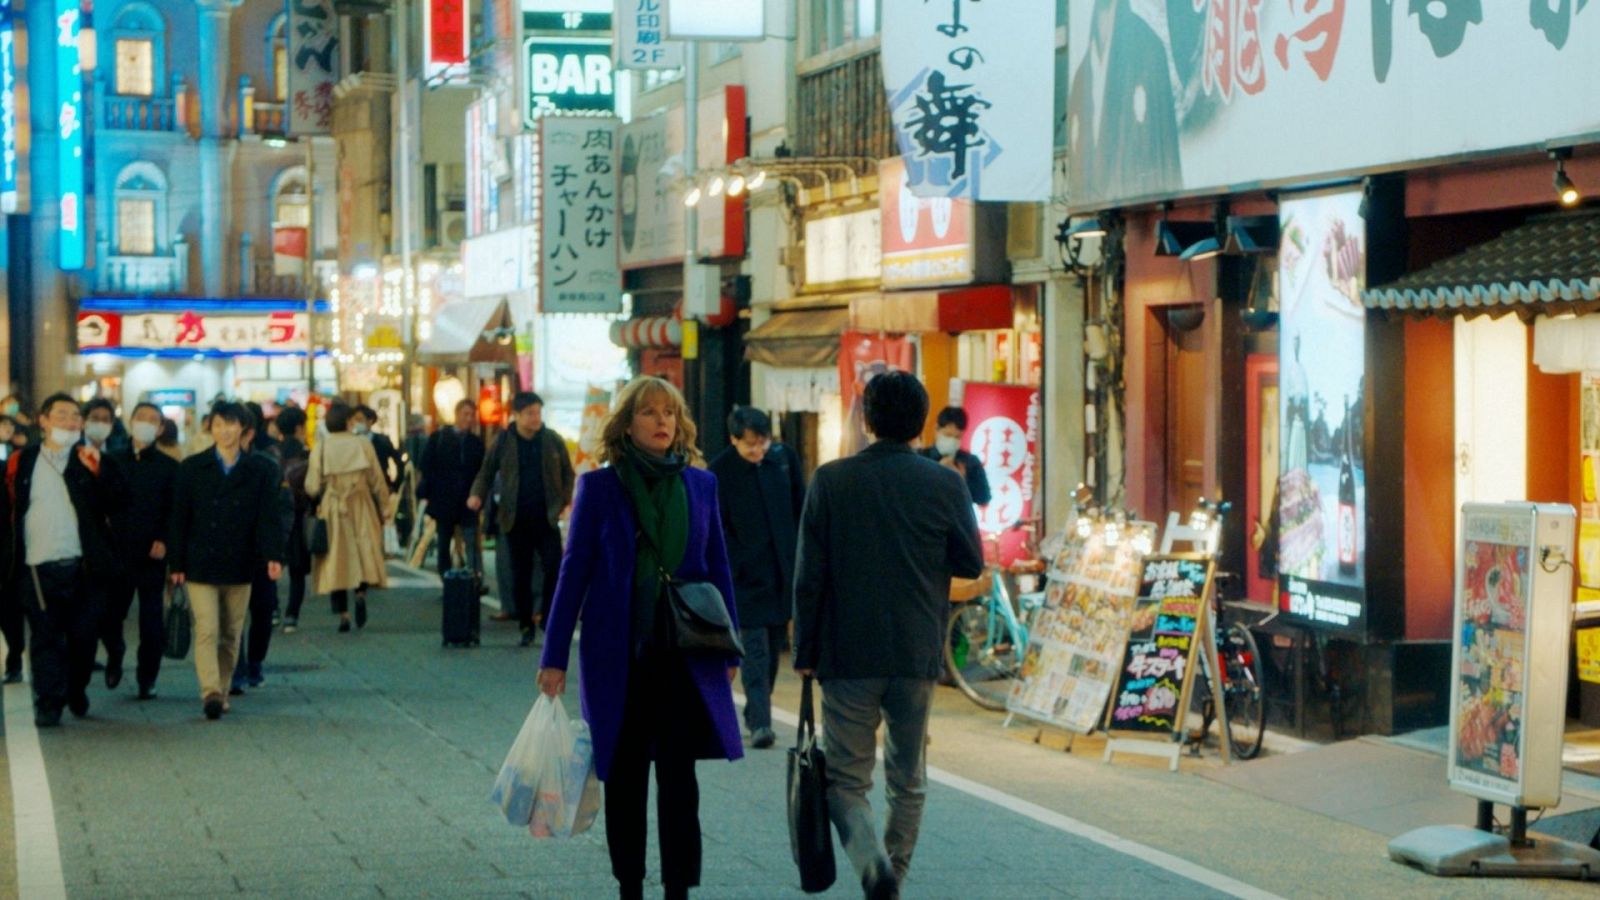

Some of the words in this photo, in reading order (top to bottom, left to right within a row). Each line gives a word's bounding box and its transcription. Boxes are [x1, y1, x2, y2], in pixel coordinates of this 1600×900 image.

[561, 12, 583, 29] 1F
[531, 53, 613, 95] BAR
[632, 48, 666, 63] 2F
[582, 129, 615, 248] 肉あんかけ
[551, 165, 579, 286] チャーハン
